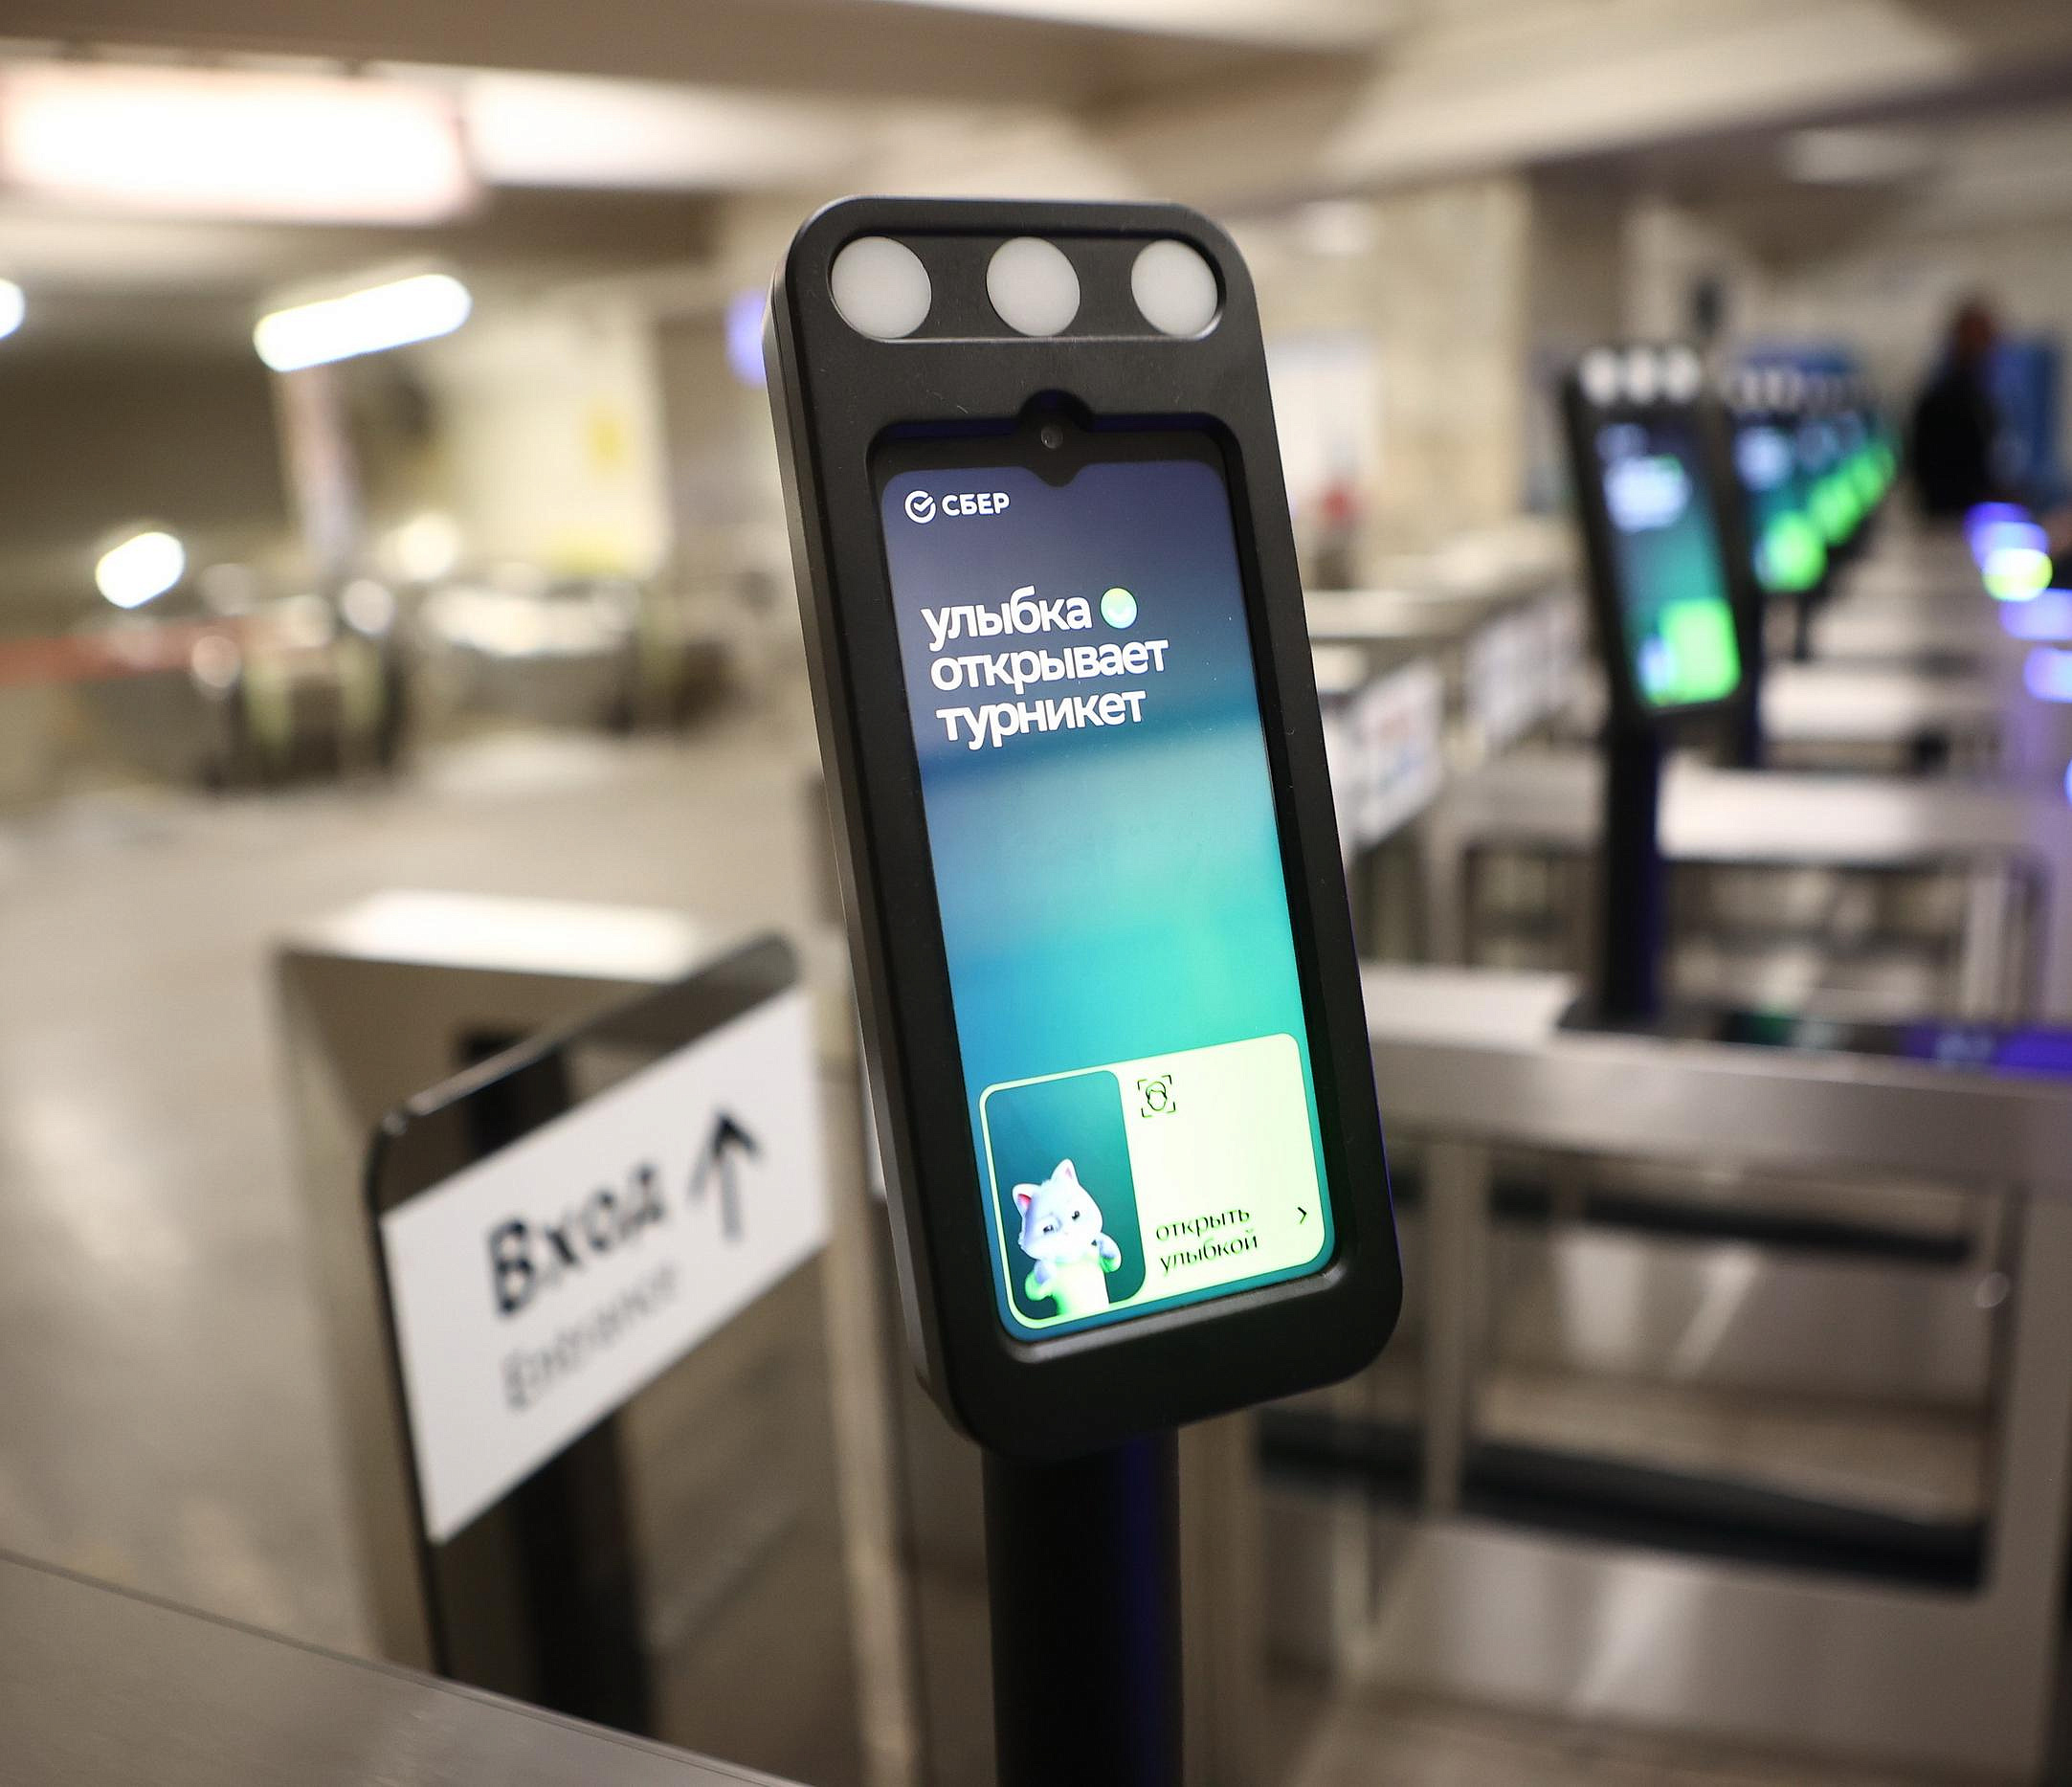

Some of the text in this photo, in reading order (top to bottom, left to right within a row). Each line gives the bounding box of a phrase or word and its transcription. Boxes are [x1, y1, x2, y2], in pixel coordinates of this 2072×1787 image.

[942, 492, 1010, 517] СБЕР
[921, 585, 1093, 652] улыбка
[930, 639, 1169, 695] открывает
[936, 690, 1146, 750] турникет
[486, 1160, 670, 1319] Вход
[1155, 1209, 1251, 1241] открыть
[1159, 1228, 1259, 1276] улыбкой
